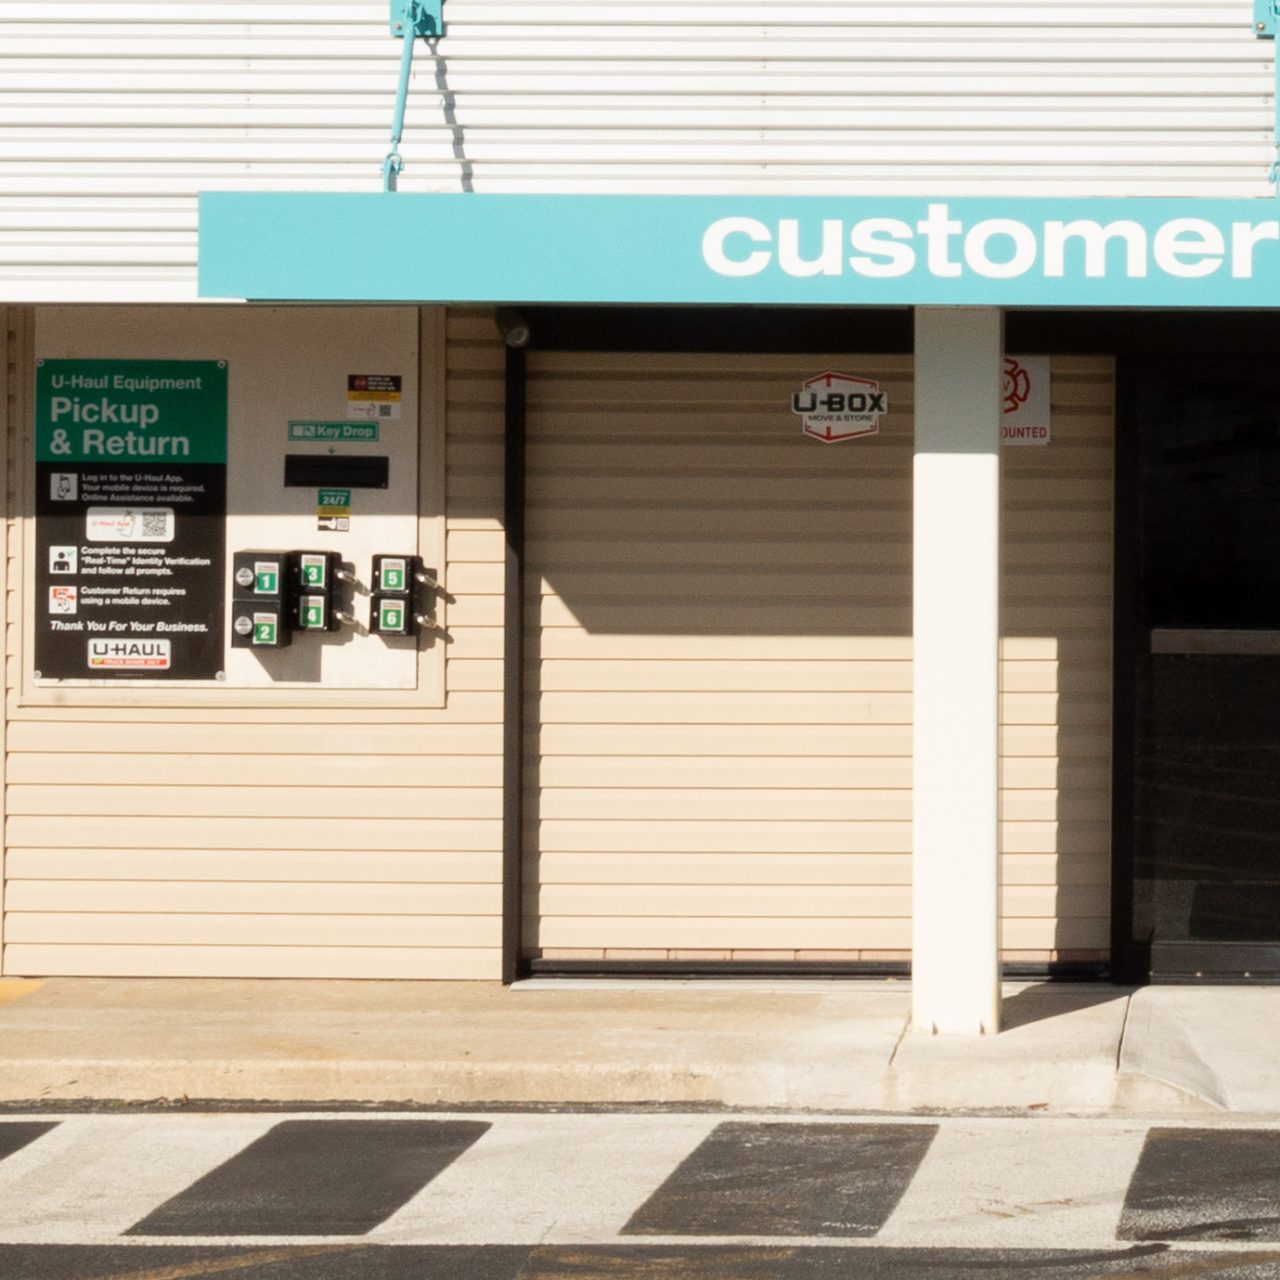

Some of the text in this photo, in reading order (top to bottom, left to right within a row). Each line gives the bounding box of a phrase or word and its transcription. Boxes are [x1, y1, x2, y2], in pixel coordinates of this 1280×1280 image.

[702, 204, 1280, 280] customer
[52, 374, 202, 392] U-Haul Equipment
[794, 392, 885, 413] U-BOX
[50, 397, 160, 429] Pickup
[809, 414, 833, 422] MOVE
[843, 414, 873, 422] STORE
[317, 425, 373, 439] Key Drop
[50, 428, 190, 456] & Return
[82, 474, 98, 483] Log
[100, 474, 108, 482] in
[109, 474, 118, 482] to
[120, 474, 133, 482] the
[134, 474, 163, 482] U-Haul
[82, 484, 101, 492] Your
[102, 484, 131, 492] mobile
[132, 484, 158, 493] device
[160, 484, 168, 493] is
[81, 493, 108, 502] Online
[110, 494, 154, 503] Assistance
[322, 496, 346, 506] 24/7
[81, 546, 166, 556] Complete the secure
[132, 557, 163, 568] Identity
[164, 558, 211, 567] Verification
[81, 567, 173, 577] and follow all prompts.
[308, 567, 318, 582] 3
[388, 571, 398, 586] 5
[262, 574, 271, 589] 1
[81, 586, 186, 597] Customer Return requires
[81, 597, 103, 606] using
[112, 596, 139, 605] mobile
[141, 597, 171, 606] device.
[307, 608, 317, 622] 4
[386, 611, 396, 626] 6
[51, 620, 208, 632] Thank You For Your Business.
[260, 625, 270, 640] 2
[93, 643, 166, 656] U-HAUL
